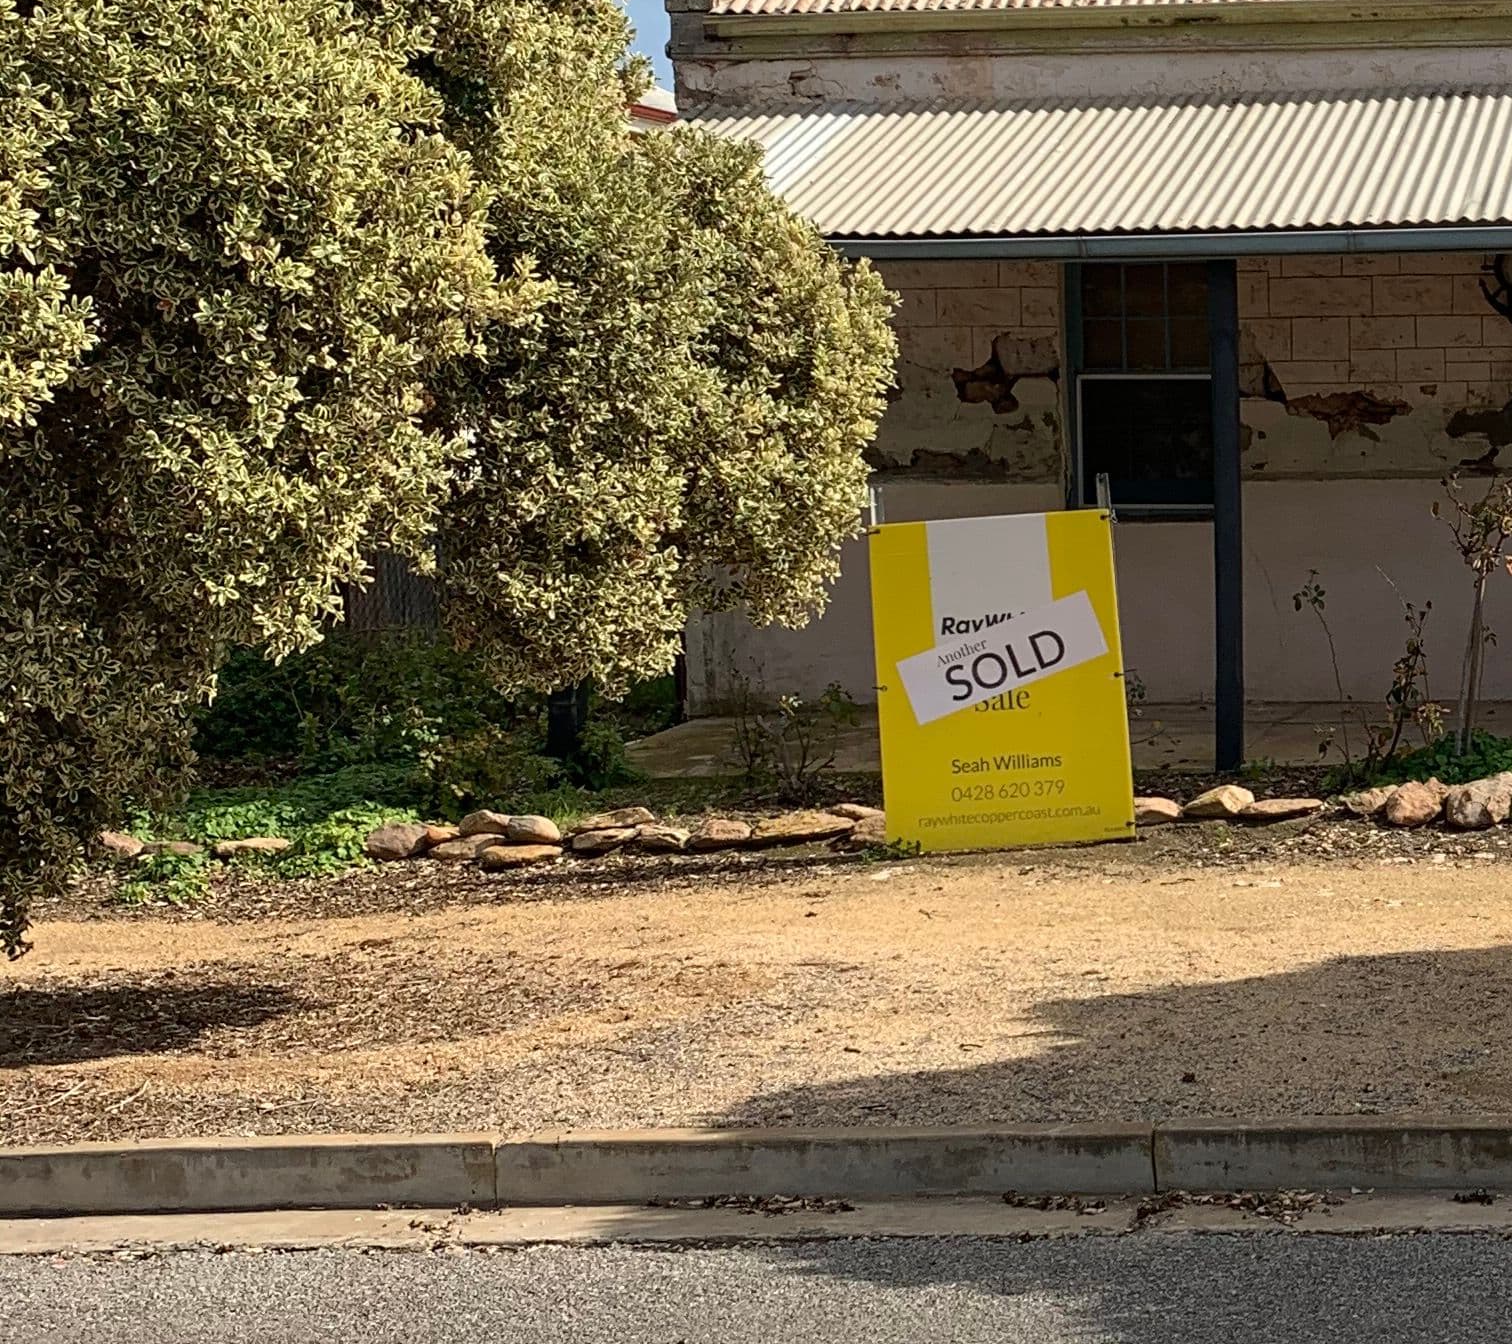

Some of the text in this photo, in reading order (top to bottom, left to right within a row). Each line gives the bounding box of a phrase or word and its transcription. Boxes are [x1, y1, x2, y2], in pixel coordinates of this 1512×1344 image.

[941, 611, 1025, 636] RayW
[937, 639, 987, 668] Another
[945, 630, 1065, 701] SOLD
[951, 754, 1062, 775] Seah Williams
[951, 778, 1065, 802] 0428 620 379
[918, 805, 1101, 829] raywhitecoppercoast.com.au
